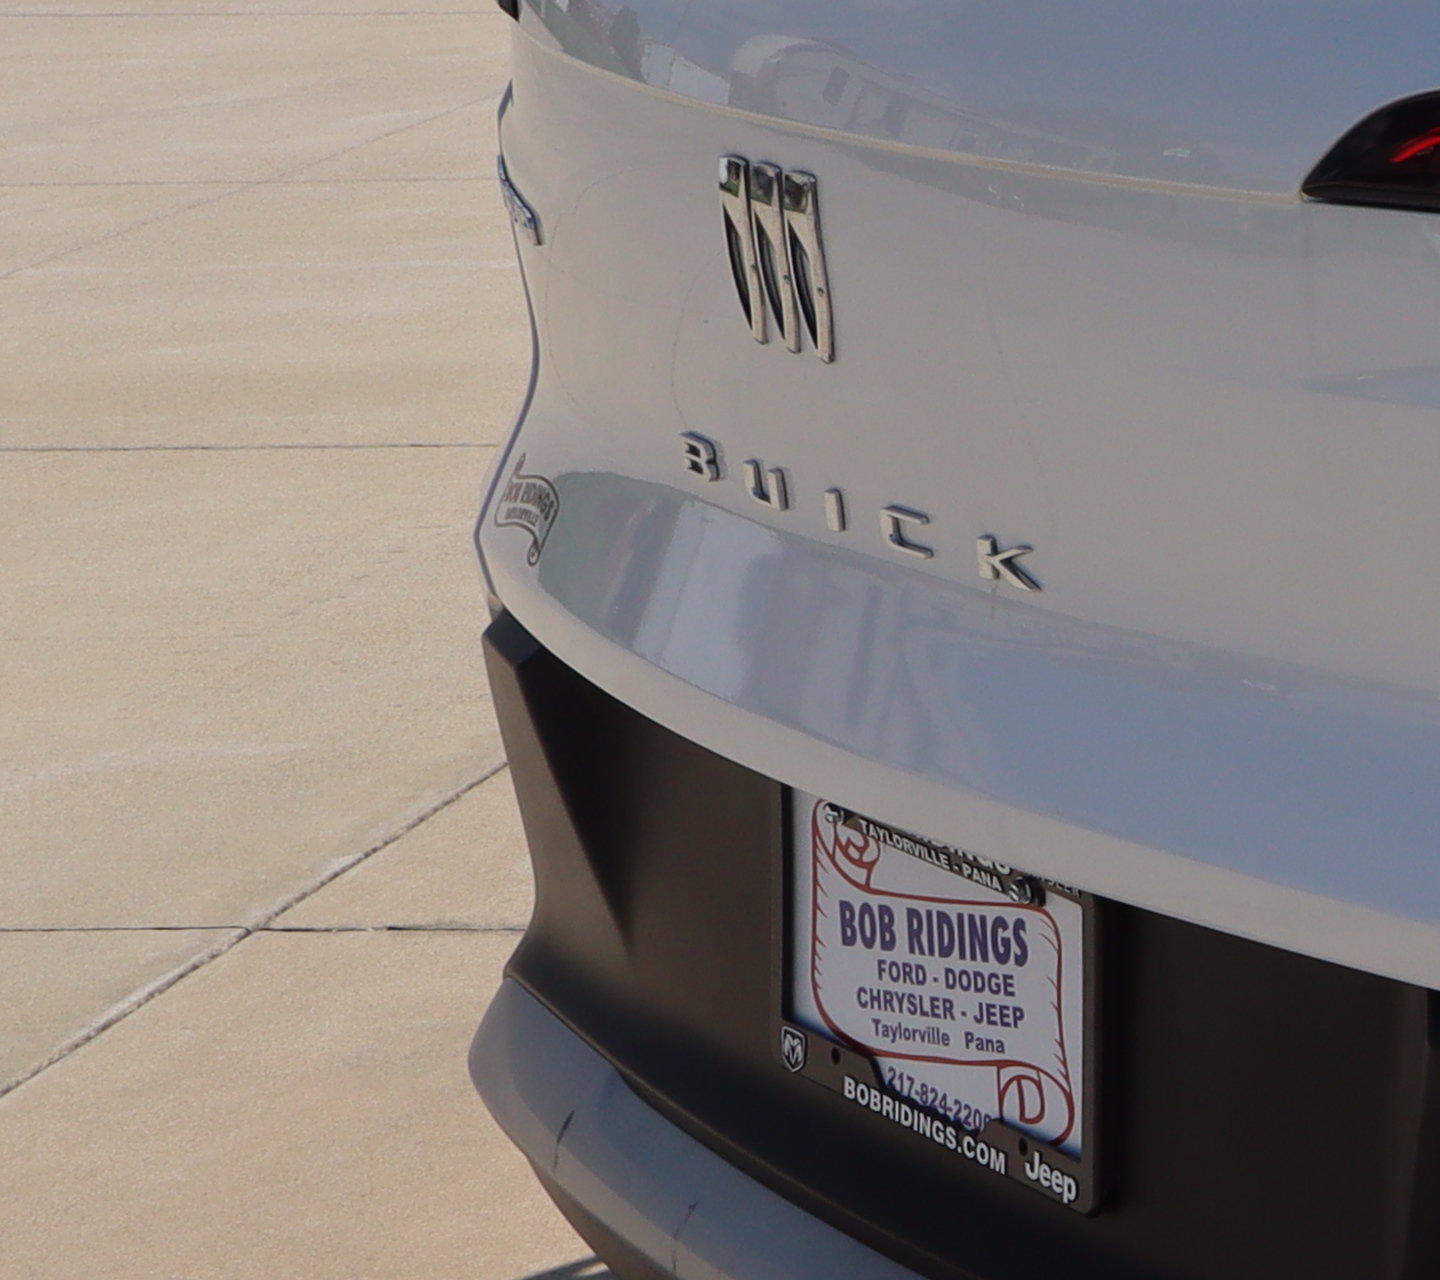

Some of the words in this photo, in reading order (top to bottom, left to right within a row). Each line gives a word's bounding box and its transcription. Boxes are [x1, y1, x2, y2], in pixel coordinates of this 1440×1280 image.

[678, 429, 1043, 593] BUICK
[858, 819, 951, 871] TAYLORVILLE
[962, 863, 1003, 893] PANA
[839, 899, 897, 952] BOB
[907, 907, 1030, 967] RIDINGS
[856, 987, 955, 1022] CHRYSLER
[973, 999, 1025, 1030] JEEP
[877, 959, 927, 987] FORD
[944, 968, 1016, 997] DODGE
[872, 1018, 950, 1048] Taylorville
[964, 1031, 1006, 1055] Pana
[843, 1075, 1007, 1175] BOBRIDINGS.COM
[1024, 1150, 1078, 1205] Jeep
